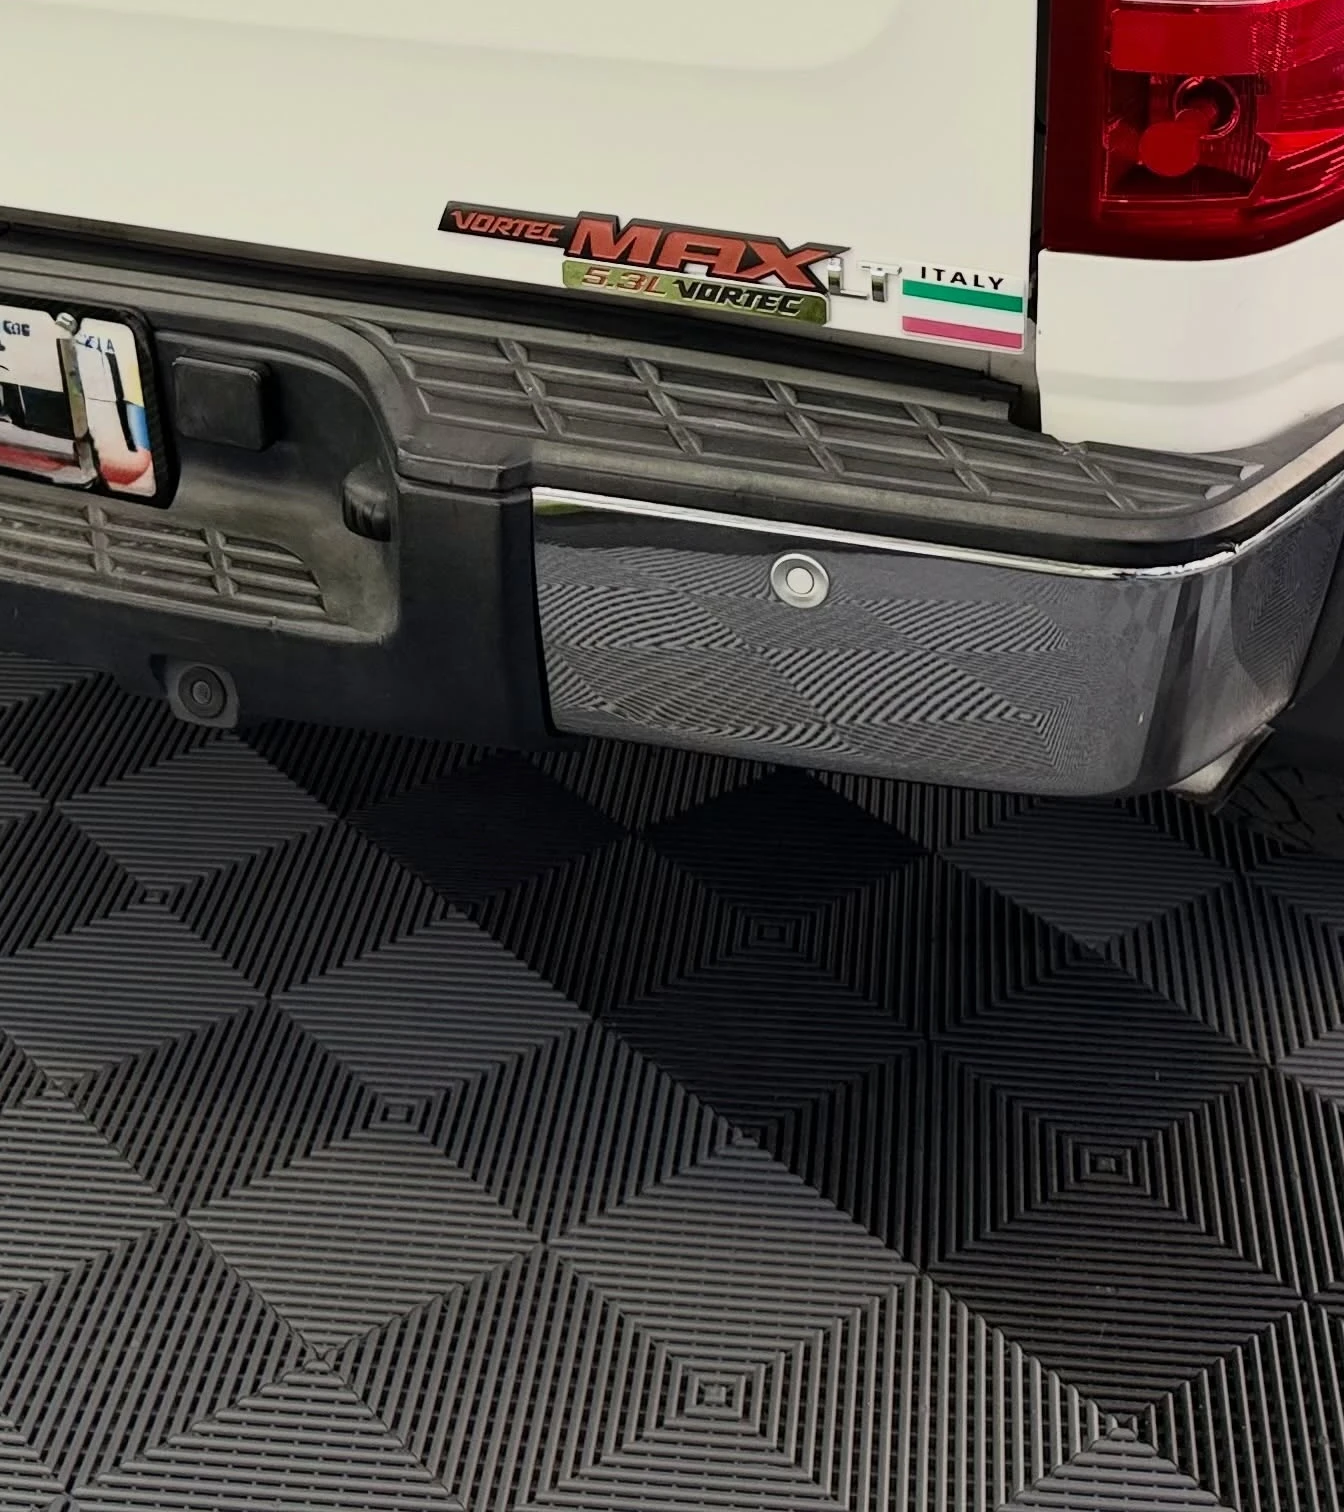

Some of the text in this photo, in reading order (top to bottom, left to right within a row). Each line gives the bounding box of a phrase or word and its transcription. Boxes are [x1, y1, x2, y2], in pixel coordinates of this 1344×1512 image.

[451, 210, 836, 290] VORTEC MAX
[580, 265, 805, 317] 5.3L VORTEC
[826, 257, 903, 303] LT
[920, 266, 1005, 290] ITALY
